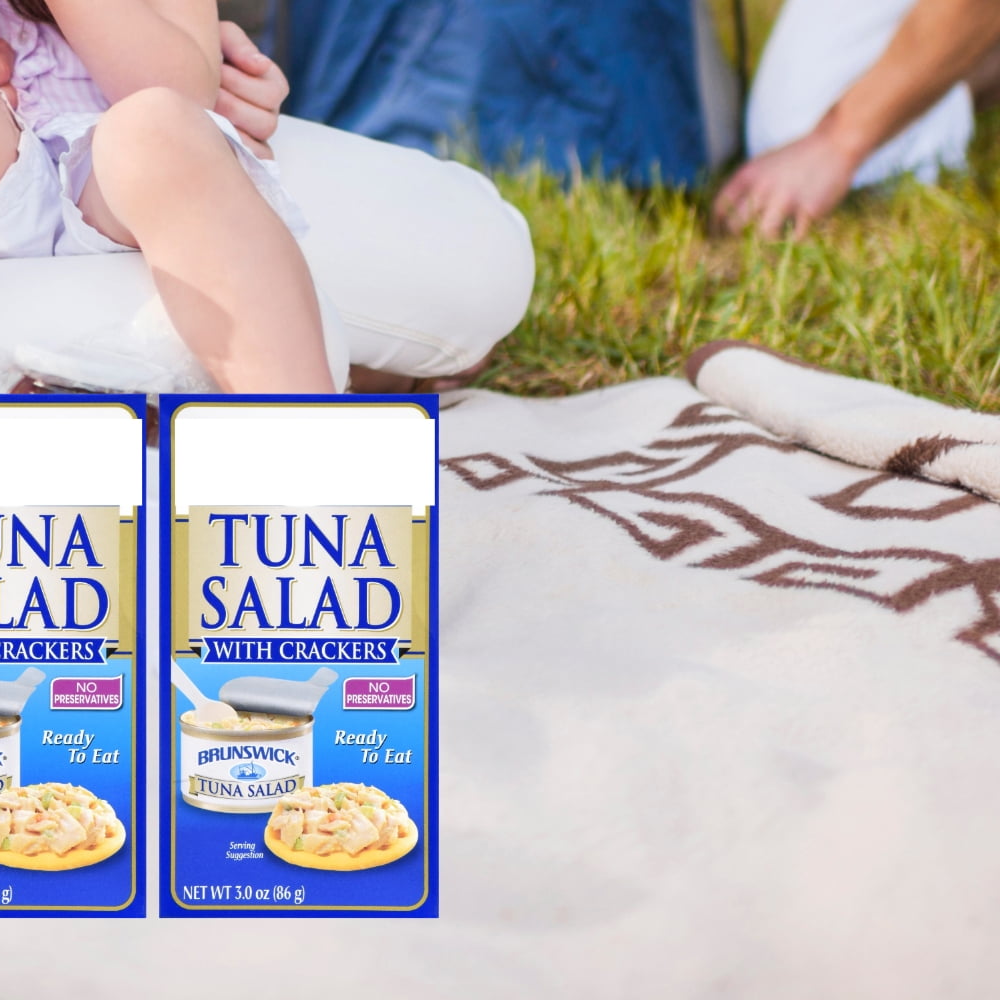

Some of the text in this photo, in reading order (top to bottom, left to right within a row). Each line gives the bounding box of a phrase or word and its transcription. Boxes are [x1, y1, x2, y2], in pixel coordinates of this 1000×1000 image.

[208, 513, 397, 568] TUNA
[201, 576, 403, 630] SALAD
[213, 641, 387, 661] WITH CRACKERS
[76, 682, 97, 693] NO
[369, 682, 390, 693] NO
[54, 694, 119, 705] PRESERVATIVES
[347, 694, 412, 705] PRESERVATIVES
[42, 729, 95, 749] Ready
[335, 729, 388, 749] Ready
[68, 749, 120, 764] To Eat
[361, 749, 413, 764] To Eat
[198, 778, 297, 797] TUNA SALAD
[229, 841, 256, 851] Serving
[225, 850, 264, 861] Suggestion
[1, 885, 13, 905] g)
[183, 885, 306, 905] NET WT 3.0 oz (86 g)
